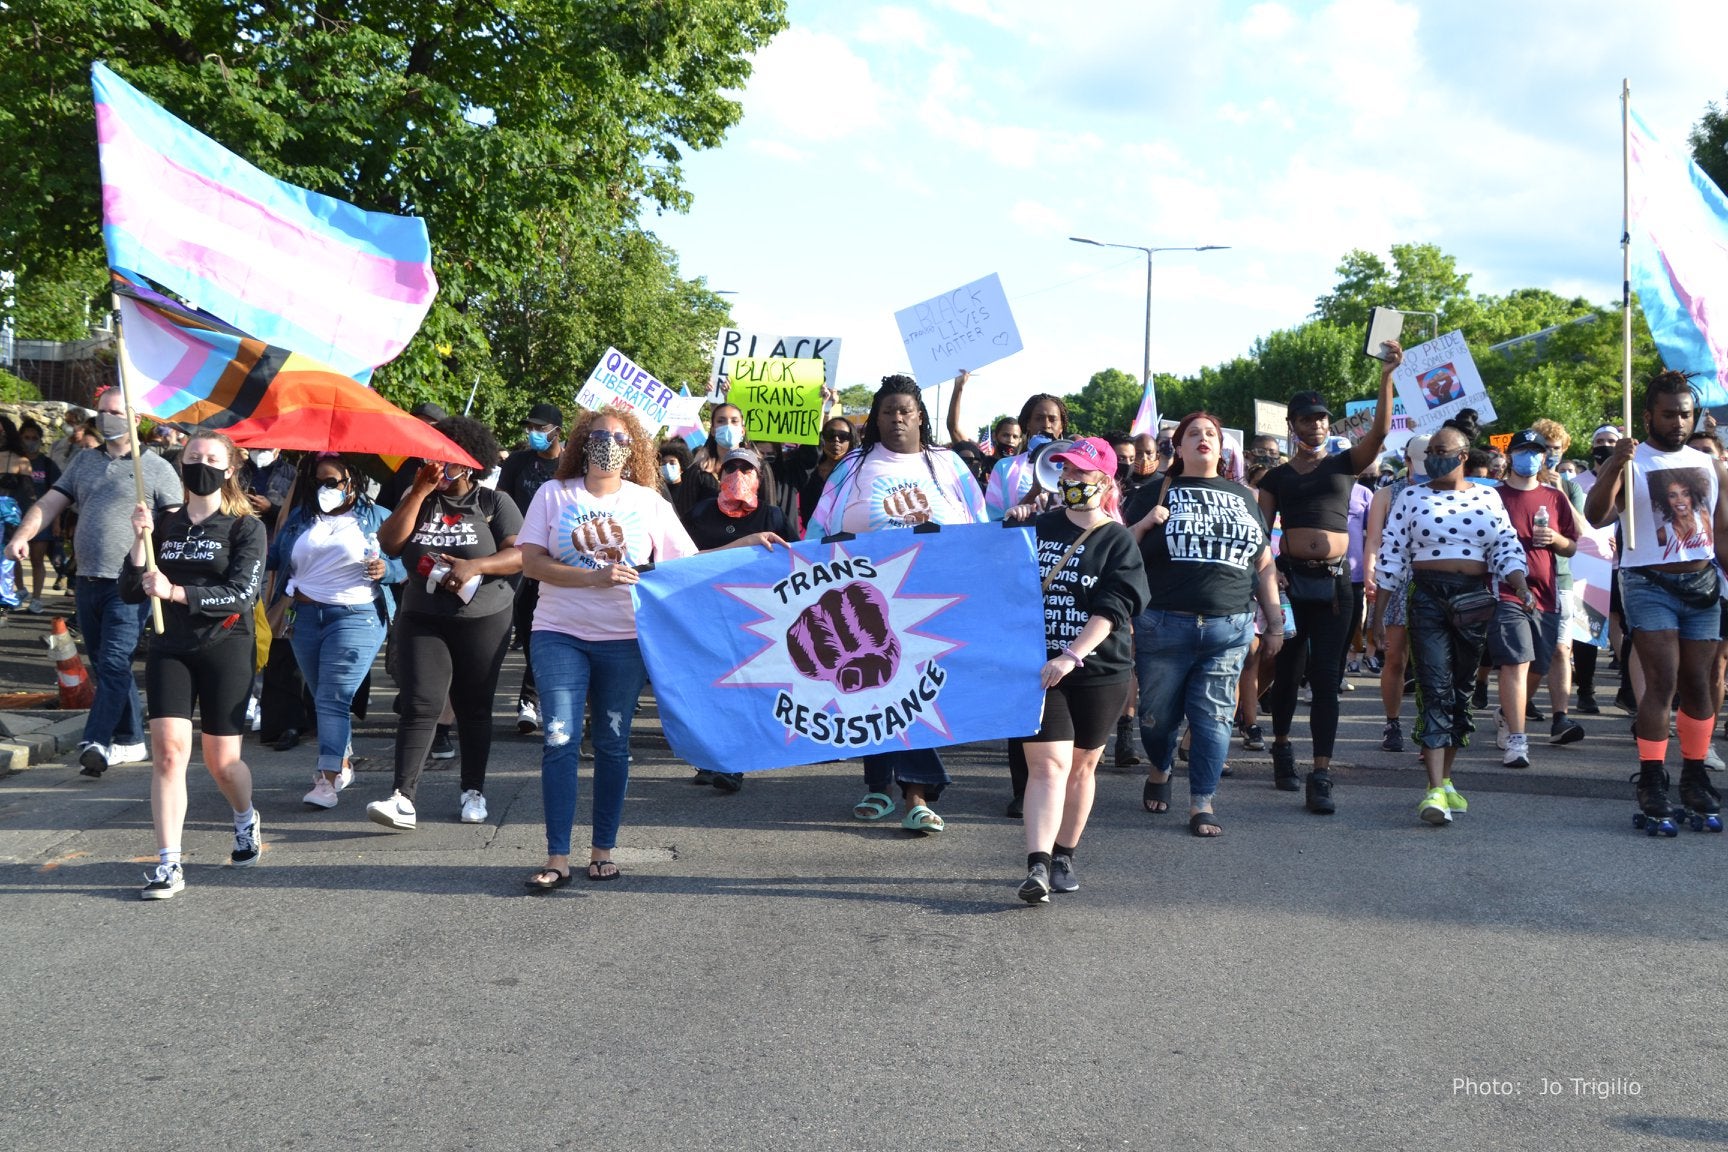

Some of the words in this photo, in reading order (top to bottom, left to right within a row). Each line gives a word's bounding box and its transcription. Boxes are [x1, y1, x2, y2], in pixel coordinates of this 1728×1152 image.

[938, 306, 990, 340] LIVES
[931, 327, 984, 361] MATTER
[1423, 332, 1459, 357] PRIDE
[607, 353, 673, 409] QUEER
[735, 360, 796, 384] BLACK
[594, 367, 667, 424] LIBERATION
[611, 396, 635, 413] NOT
[746, 385, 804, 407] TRANS
[767, 409, 819, 437] MATTER
[886, 481, 918, 495] TRANS
[1168, 489, 1198, 504] ALL
[1202, 490, 1248, 514] LIVES
[1170, 502, 1203, 515] CAN'T
[433, 512, 443, 523] I
[575, 510, 614, 525] TRANS
[1194, 513, 1236, 525] UNTIL
[419, 522, 476, 534] BLACK
[1165, 520, 1215, 537] BLACK
[1222, 522, 1263, 545] LIVES
[411, 533, 479, 547] PEOPLE
[1037, 540, 1064, 552] you
[160, 550, 183, 560] NOT
[1166, 534, 1258, 567] MATTER
[773, 558, 878, 605] TRANS
[1080, 574, 1099, 589] of
[1065, 608, 1089, 623] the
[1060, 622, 1084, 637] the
[775, 659, 945, 746] RESISTANCE
